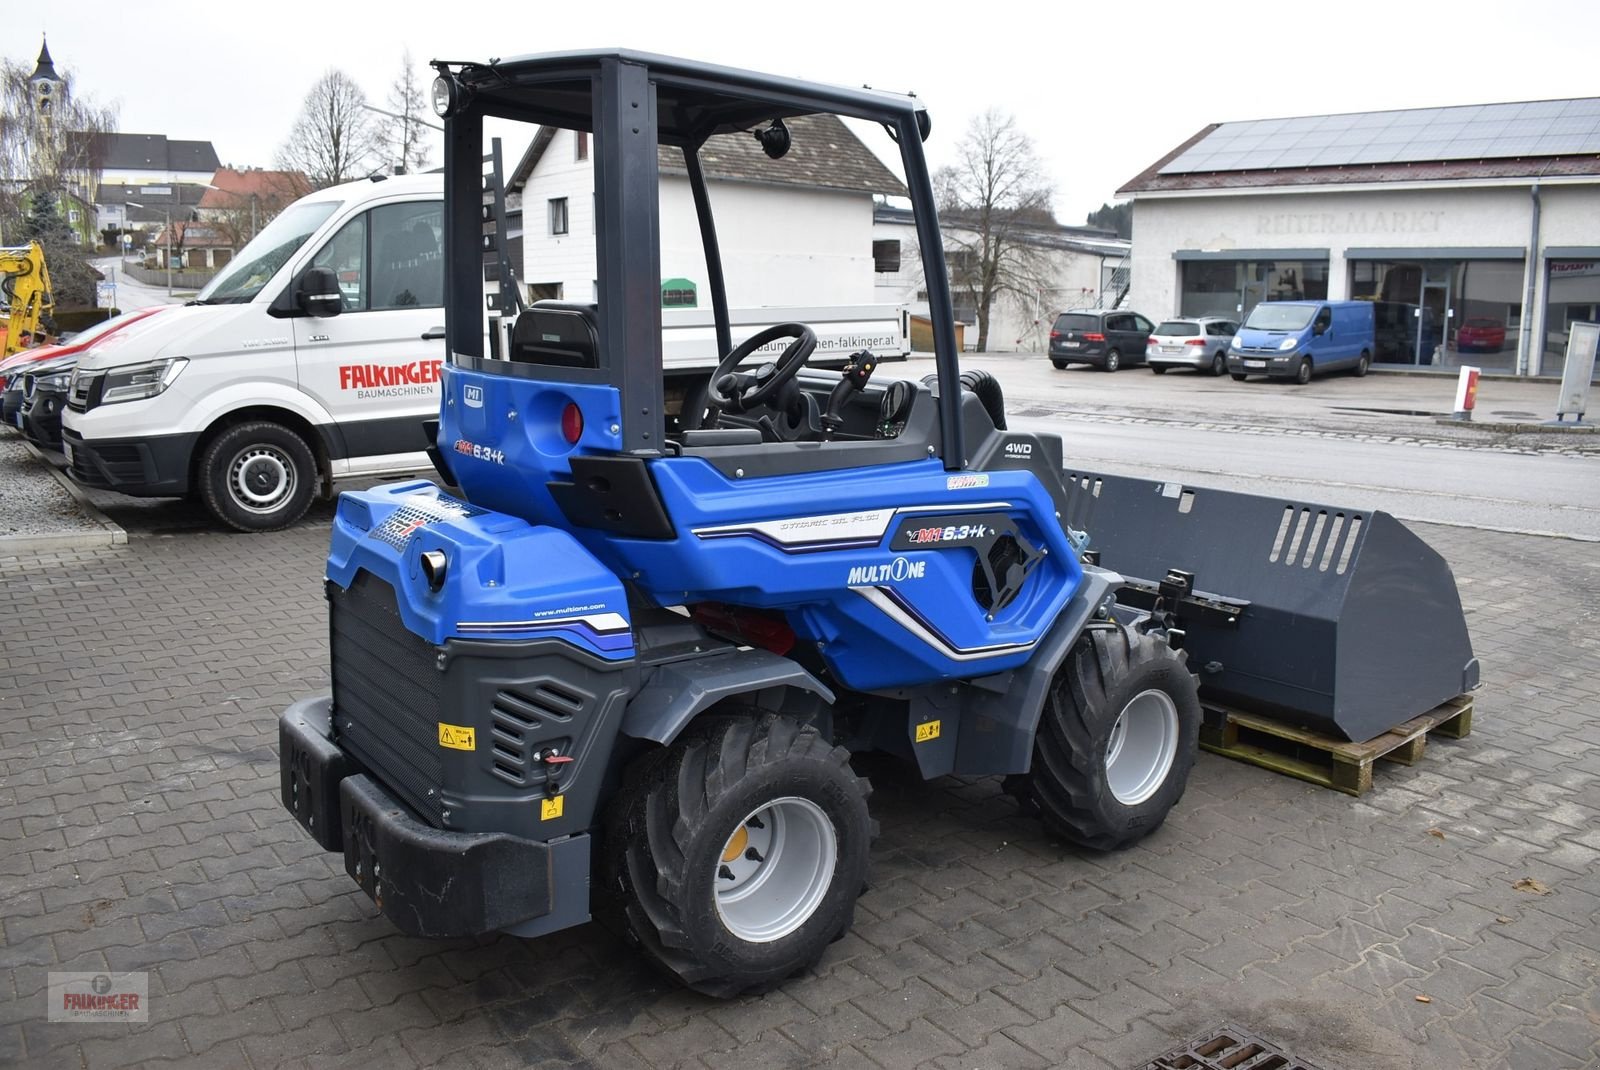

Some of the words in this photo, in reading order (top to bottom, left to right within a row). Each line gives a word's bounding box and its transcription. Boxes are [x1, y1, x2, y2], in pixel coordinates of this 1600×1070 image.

[339, 360, 443, 390] FALKINGER
[358, 386, 433, 399] BAUMASCHINEN
[1005, 443, 1032, 454] 4WD
[942, 524, 986, 540] 6.3+k
[534, 603, 606, 617] www.multione.com
